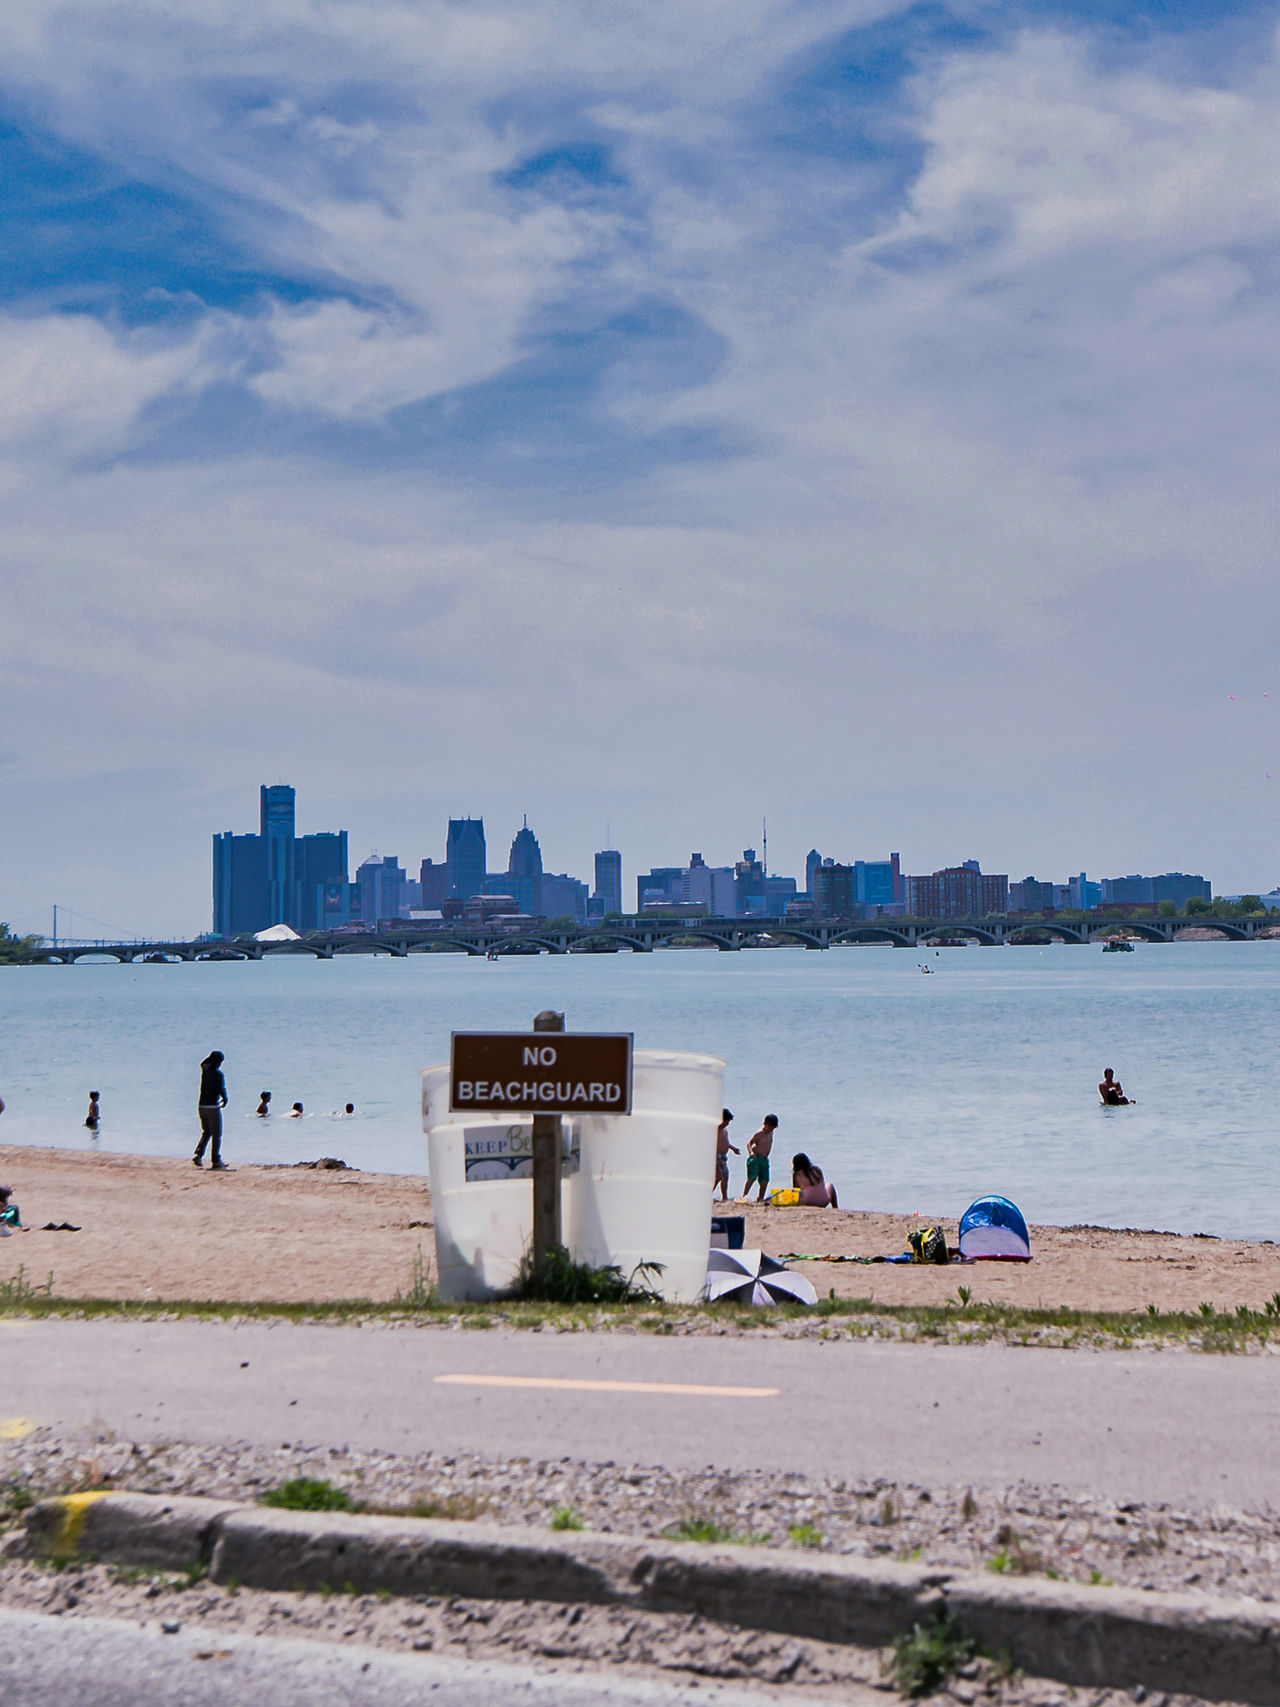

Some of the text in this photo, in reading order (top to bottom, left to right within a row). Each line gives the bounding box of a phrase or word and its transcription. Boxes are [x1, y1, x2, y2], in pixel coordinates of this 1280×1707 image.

[523, 1047, 557, 1066] NO
[458, 1081, 621, 1103] BEACHGUARD
[465, 1125, 533, 1155] KEEP Be
